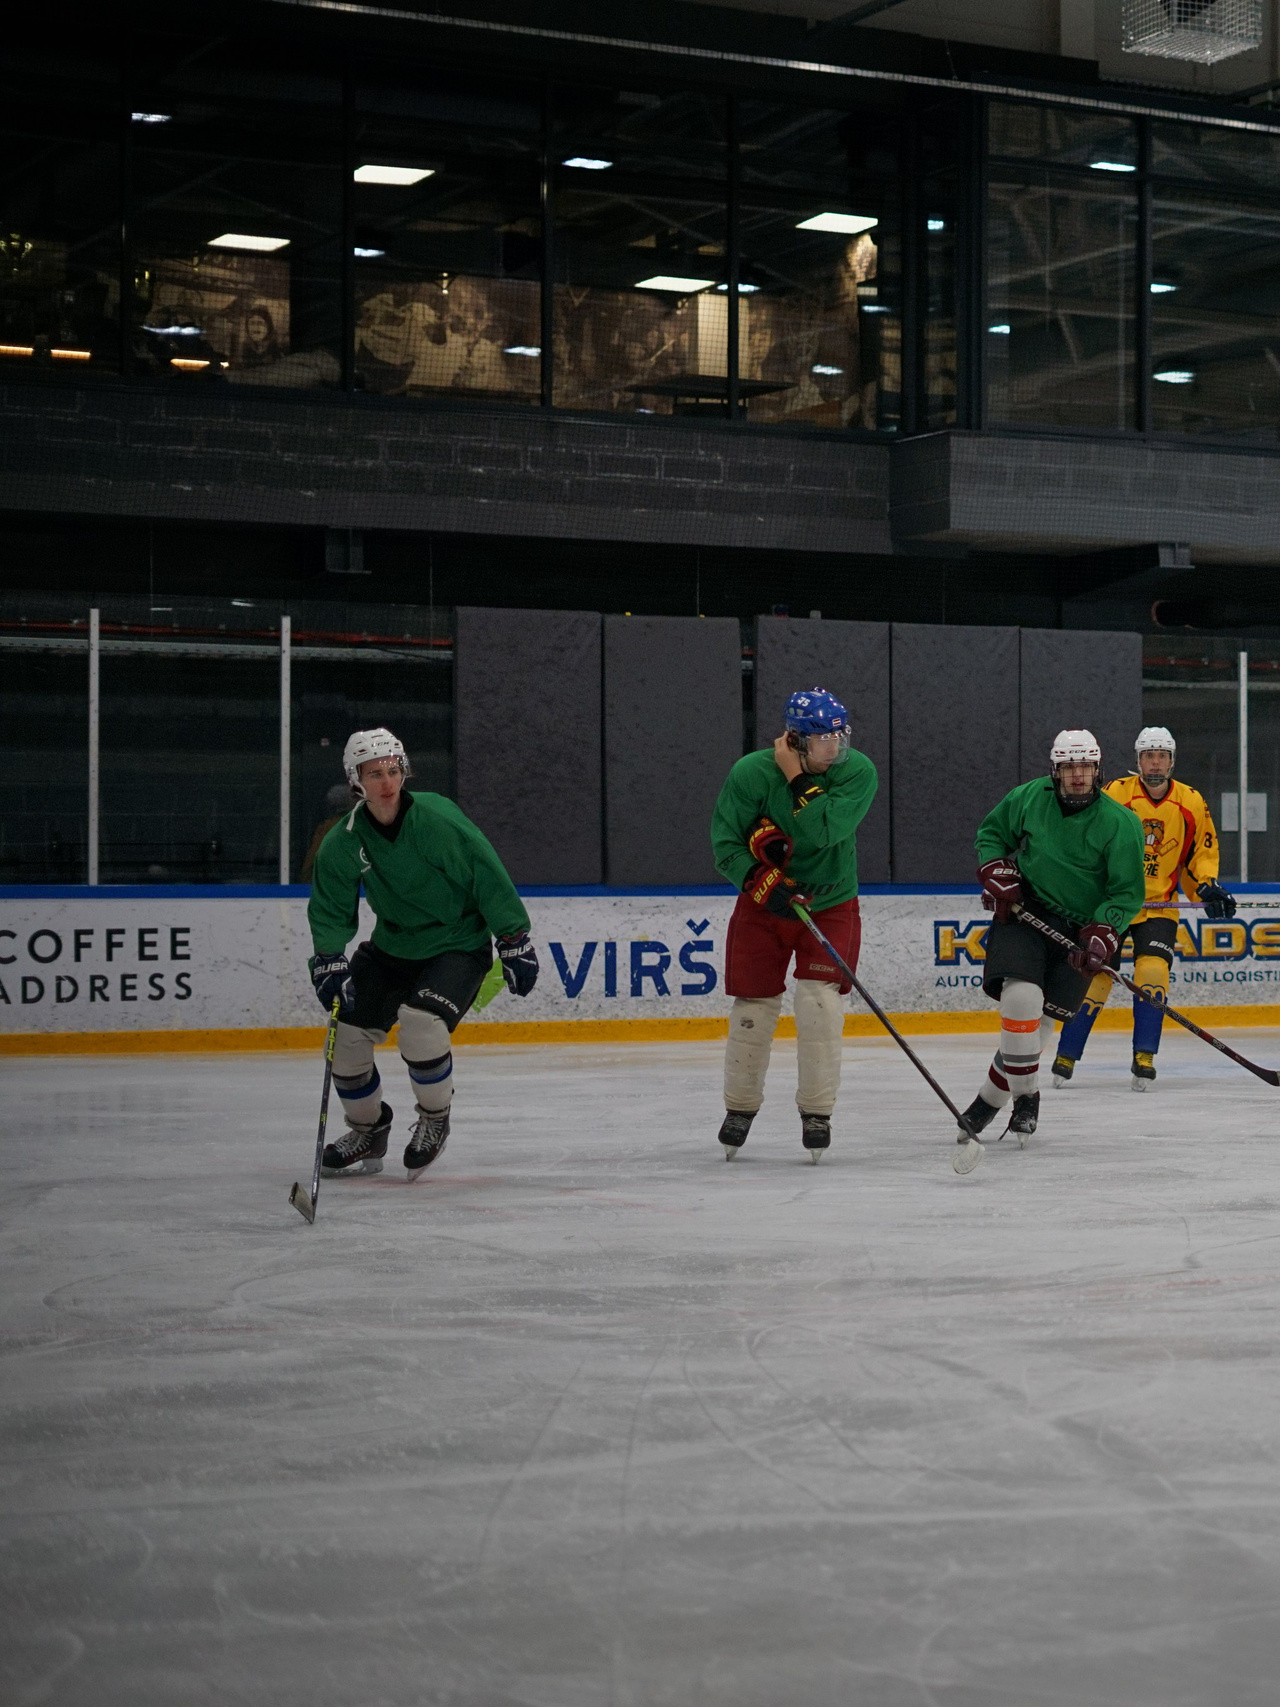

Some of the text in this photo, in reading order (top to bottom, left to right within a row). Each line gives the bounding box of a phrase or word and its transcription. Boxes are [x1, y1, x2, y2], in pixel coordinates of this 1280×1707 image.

[993, 867, 1022, 878] BAU
[1020, 910, 1079, 950] BAUER
[0, 927, 192, 965] COFFEE
[500, 942, 533, 959] BAUE
[548, 918, 718, 998] VIRŠ
[423, 990, 460, 1014] EASTON
